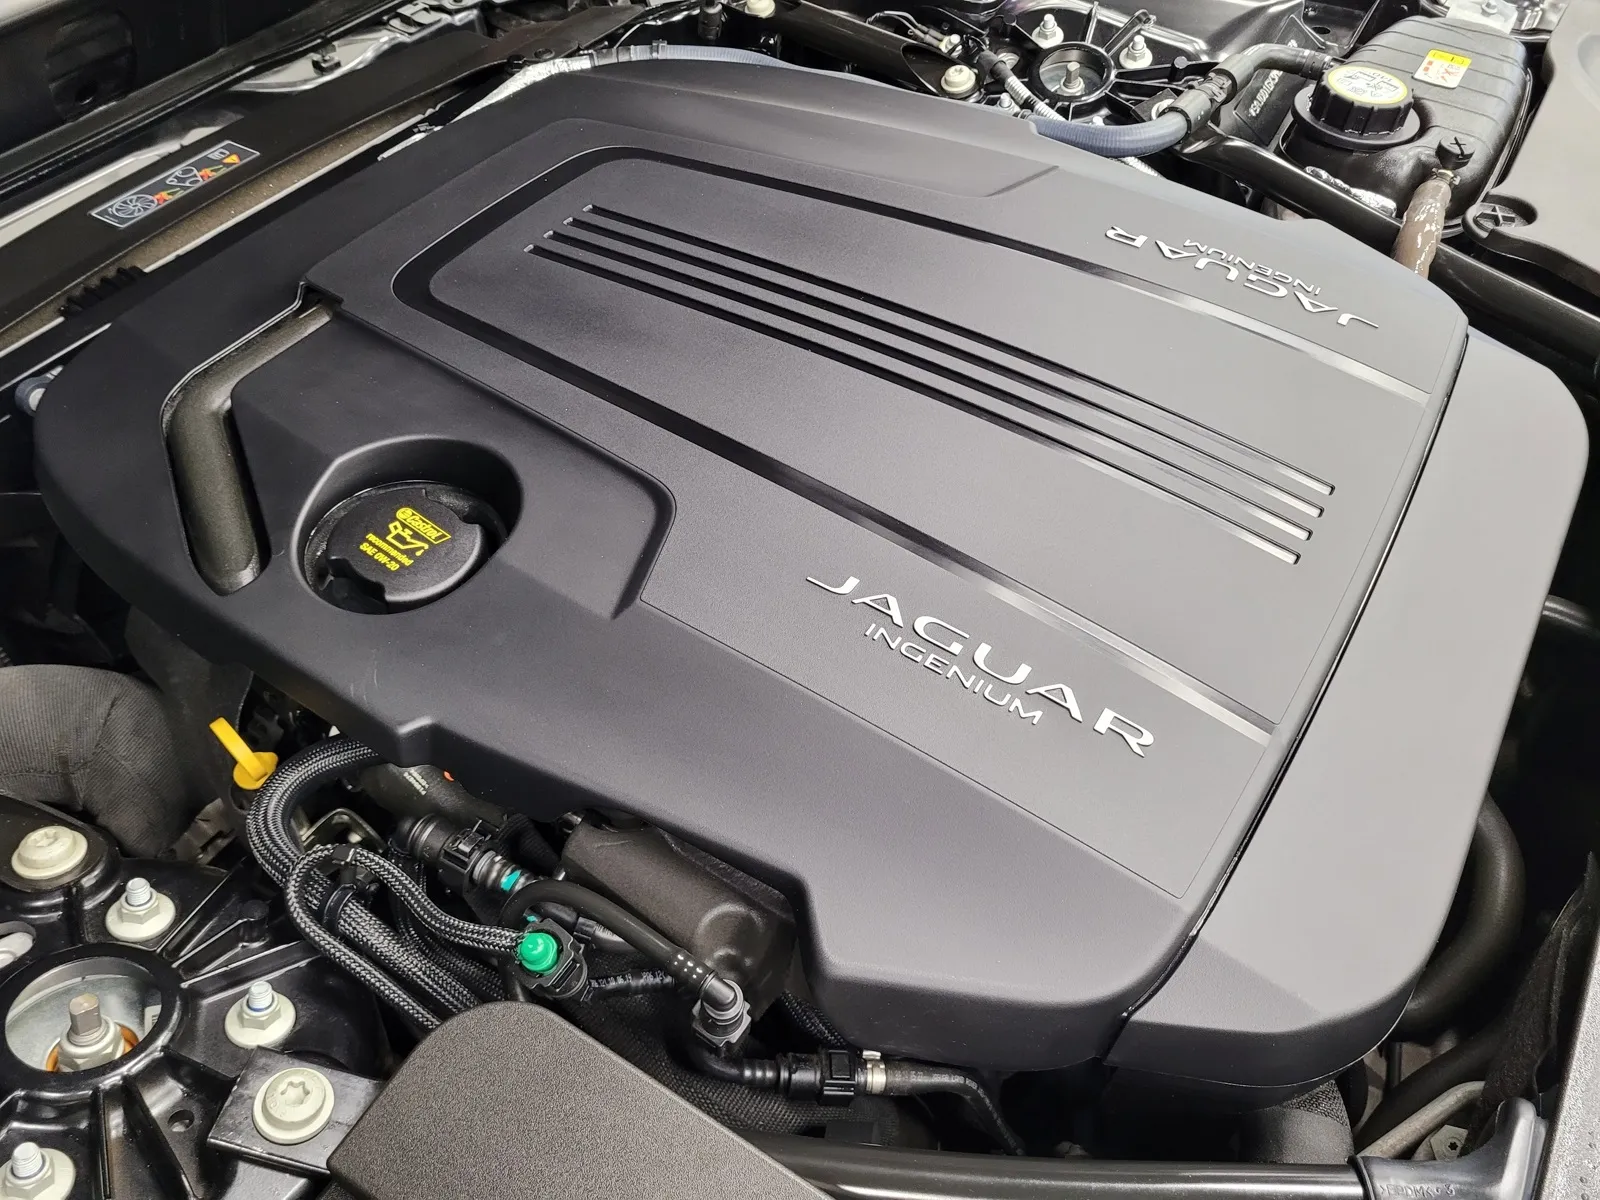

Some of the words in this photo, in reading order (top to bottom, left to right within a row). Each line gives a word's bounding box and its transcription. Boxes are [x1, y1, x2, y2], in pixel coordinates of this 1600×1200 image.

[1104, 225, 1379, 328] JAGUAR
[1183, 238, 1322, 296] INGENIUM
[359, 542, 379, 556] SAE
[373, 551, 400, 571] 0W-20
[365, 532, 415, 567] recommended
[405, 514, 444, 541] Castrol
[805, 575, 1155, 758] JAGUAR
[863, 622, 1044, 725] INGENIUM
